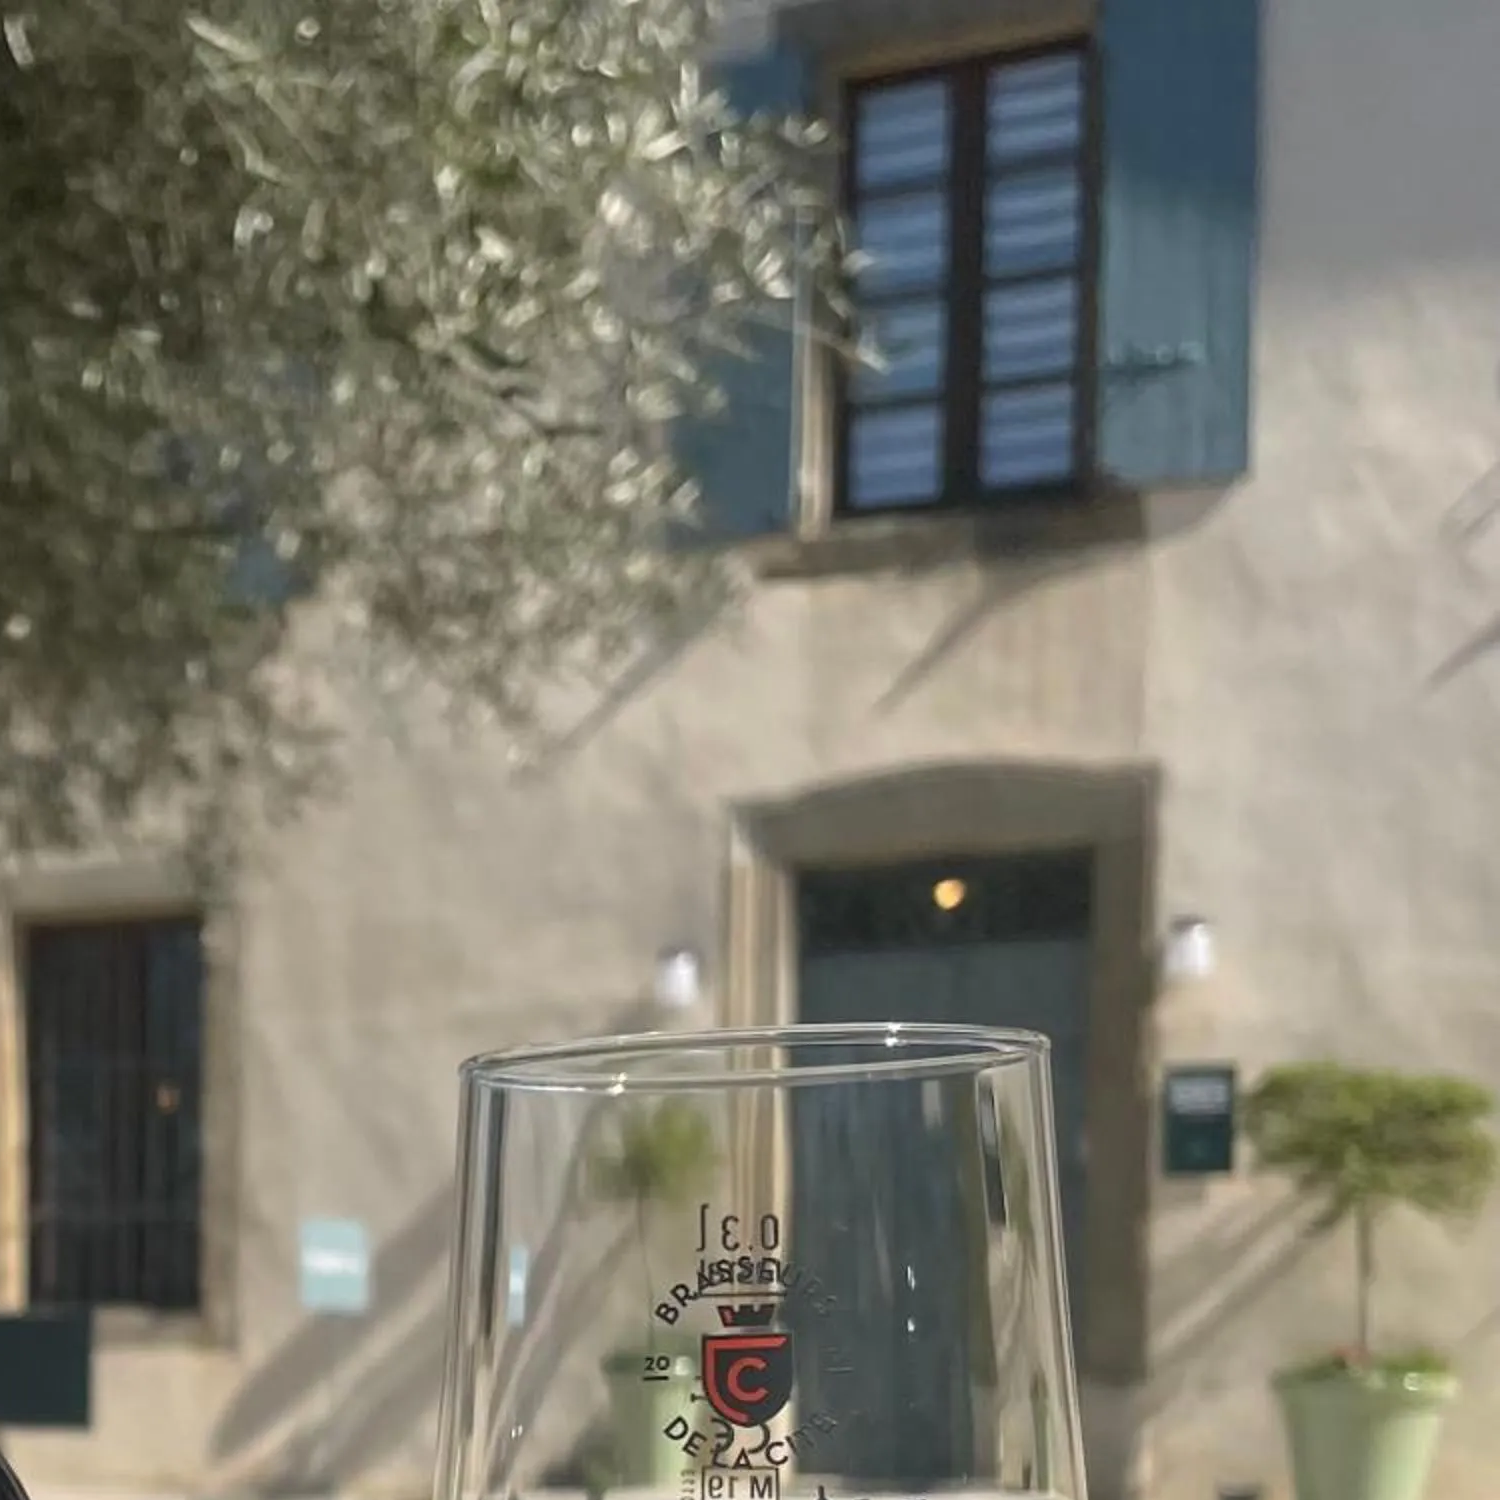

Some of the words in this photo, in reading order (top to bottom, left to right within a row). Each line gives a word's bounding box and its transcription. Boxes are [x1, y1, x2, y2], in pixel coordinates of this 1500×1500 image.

[644, 1356, 670, 1371] 20
[727, 1357, 770, 1402] C
[663, 1416, 707, 1458] DE
